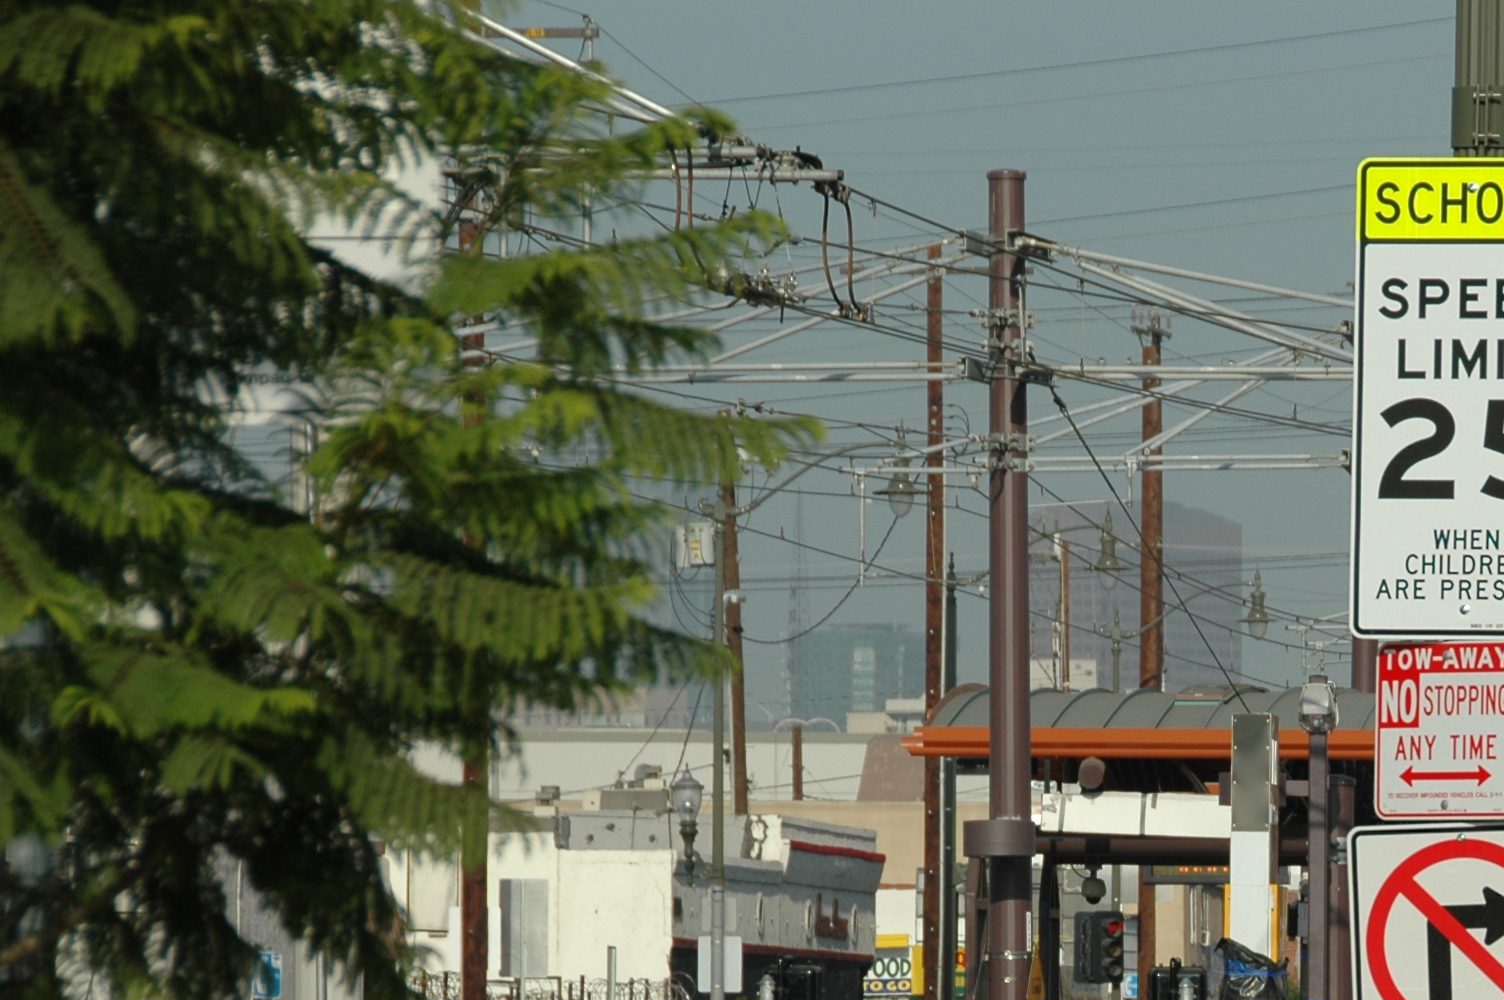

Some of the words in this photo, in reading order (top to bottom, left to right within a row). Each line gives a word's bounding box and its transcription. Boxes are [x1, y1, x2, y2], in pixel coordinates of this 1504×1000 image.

[1433, 528, 1501, 551] WHEN
[1375, 578, 1426, 600] ARE
[1380, 678, 1418, 724] NO
[1394, 735, 1437, 761] ANY
[1450, 734, 1498, 760] TIME
